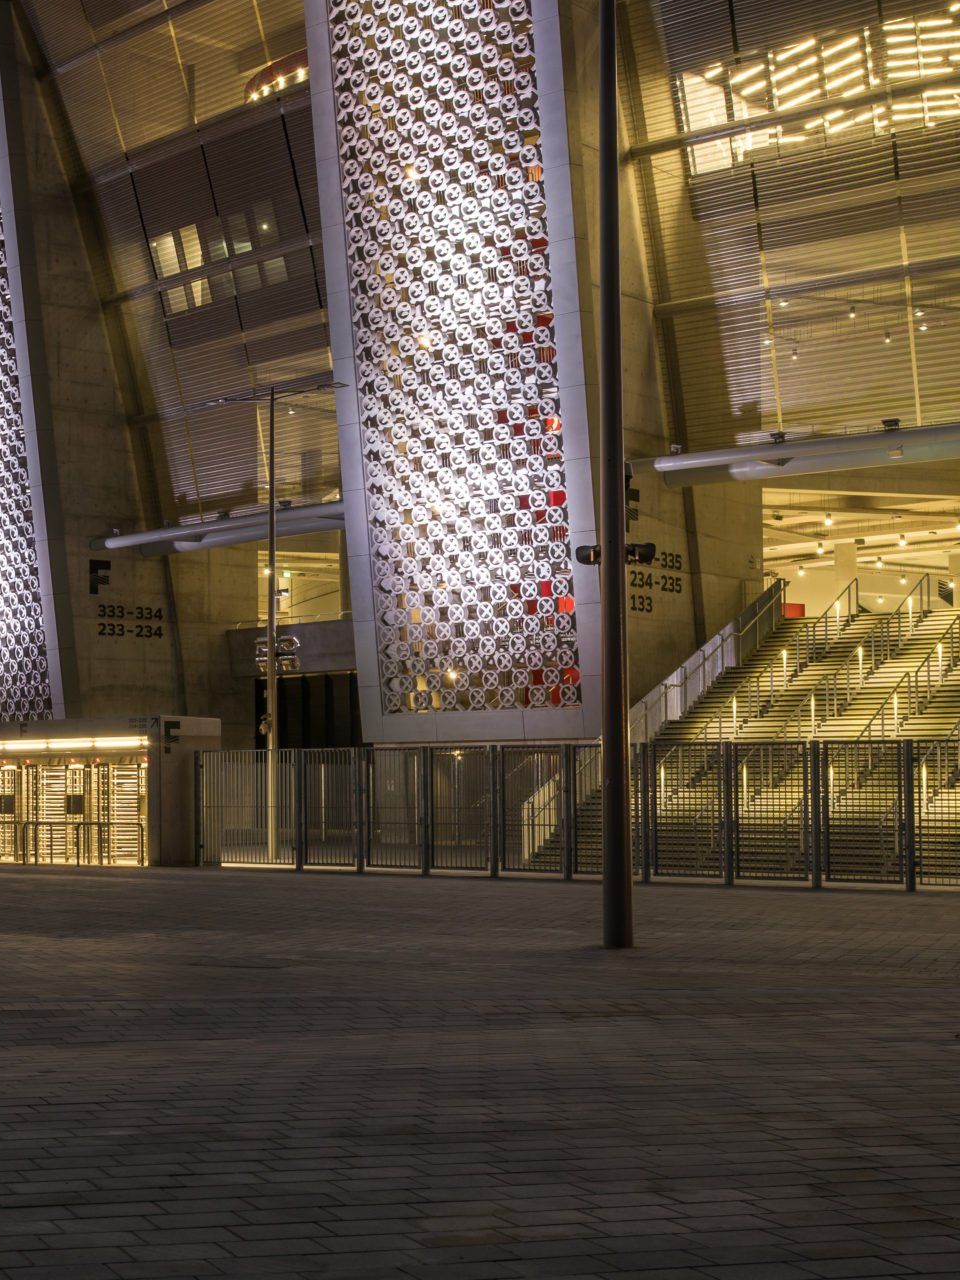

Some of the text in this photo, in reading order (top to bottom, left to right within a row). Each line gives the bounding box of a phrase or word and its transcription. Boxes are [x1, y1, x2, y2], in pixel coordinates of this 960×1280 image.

[89, 559, 111, 594] F
[630, 570, 682, 593] 234-235
[97, 604, 163, 620] 333-334
[630, 594, 653, 613] 133
[97, 623, 163, 639] 233-234
[20, 723, 28, 738] F
[164, 720, 181, 754] F
